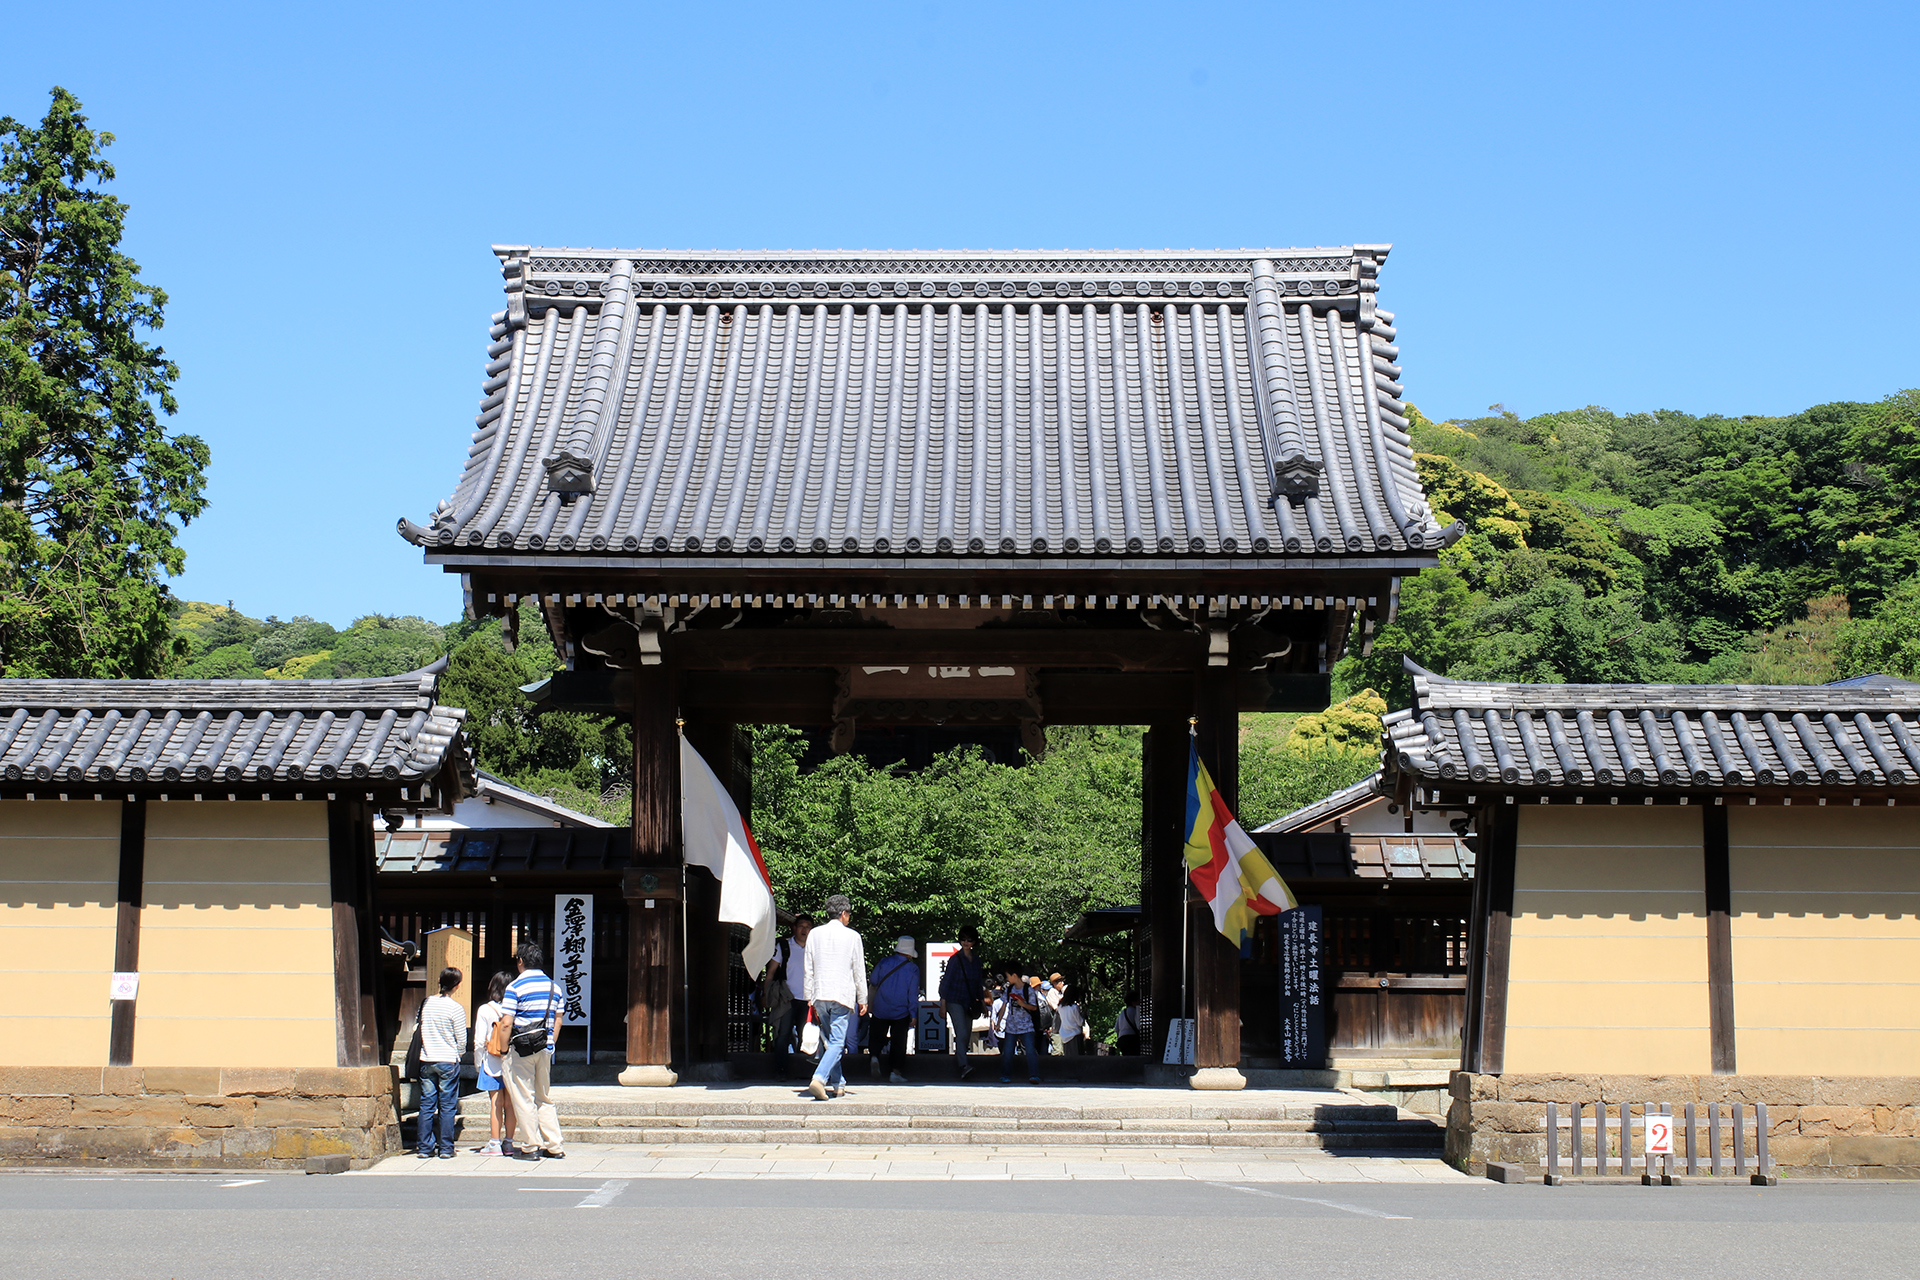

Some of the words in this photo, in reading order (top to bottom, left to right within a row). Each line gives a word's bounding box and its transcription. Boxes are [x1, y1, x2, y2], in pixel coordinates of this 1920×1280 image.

[560, 897, 587, 1022] 金澤翔子書展
[1308, 920, 1319, 1006] 建長寺土曜法話
[924, 1011, 940, 1041] 入口
[1651, 1123, 1668, 1151] 2
